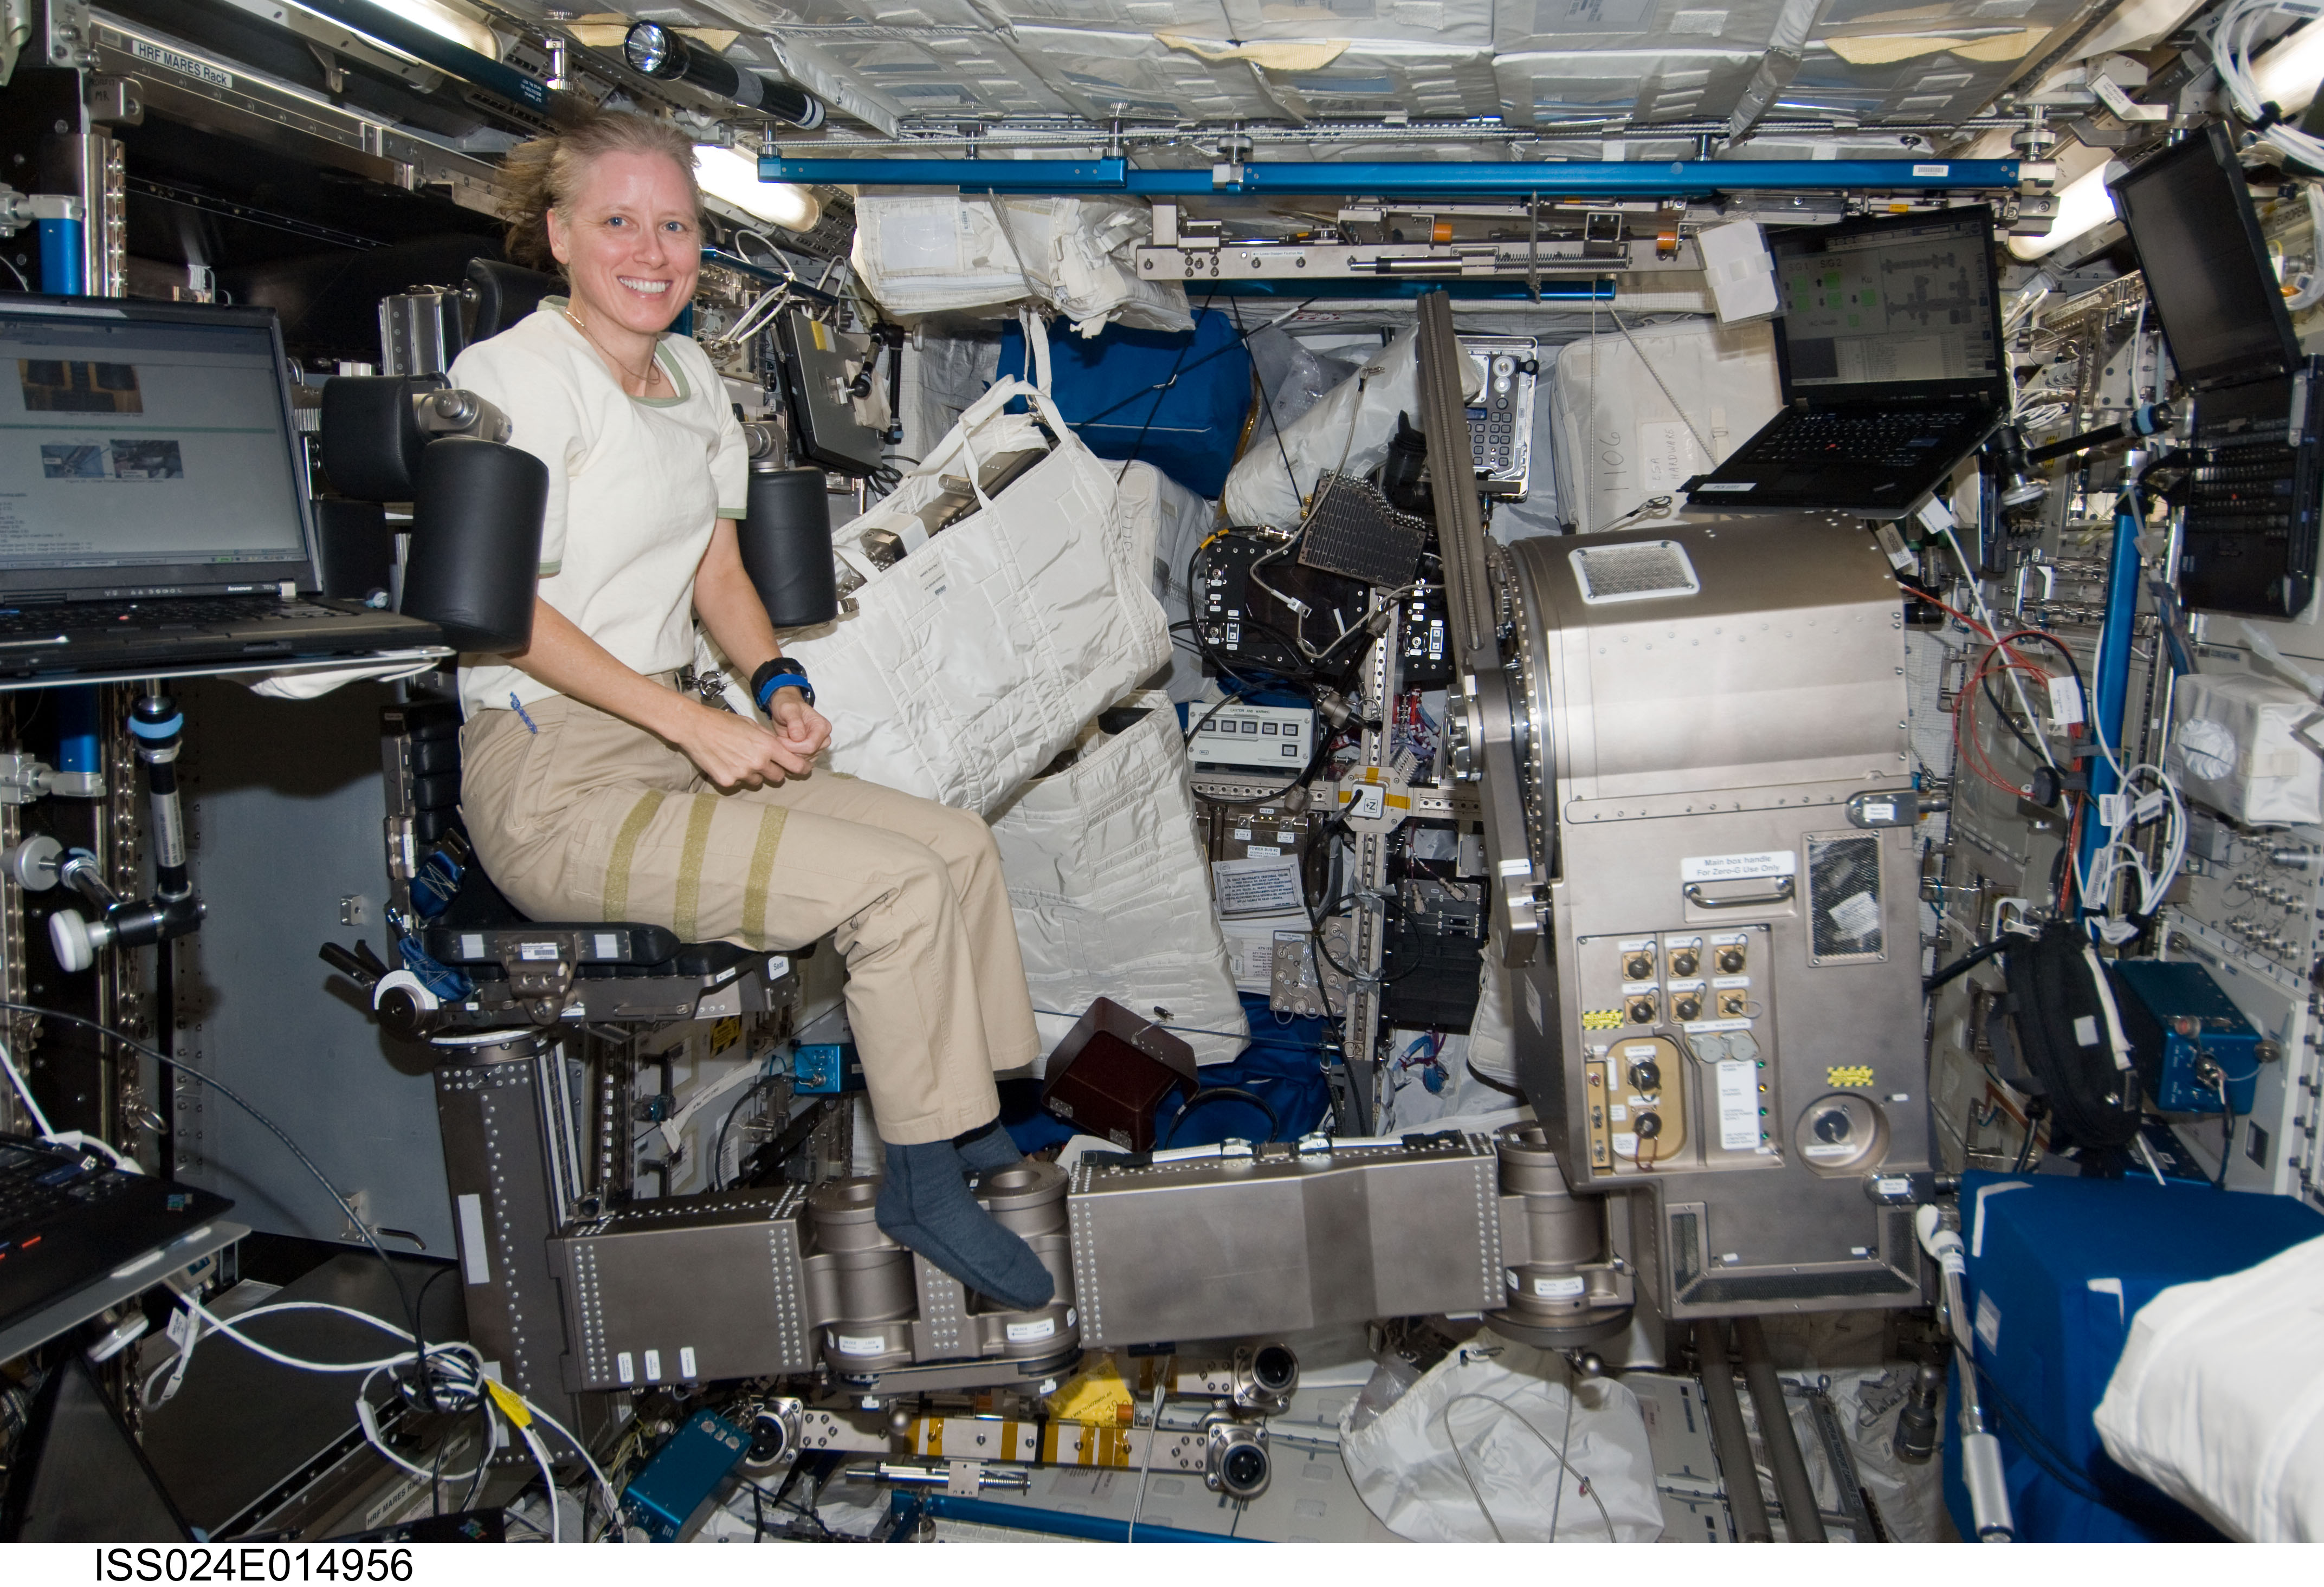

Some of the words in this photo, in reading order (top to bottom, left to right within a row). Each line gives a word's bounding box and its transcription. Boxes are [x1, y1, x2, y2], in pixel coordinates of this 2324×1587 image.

[139, 43, 161, 59] HRF
[164, 53, 201, 76] MARES
[204, 67, 227, 86] Rack
[1861, 275, 1873, 284] Ku
[1599, 432, 1629, 491] 1106
[1664, 429, 1680, 480] HARDWARE
[1650, 457, 1662, 481] ESA
[1365, 801, 1376, 810] +Z
[1713, 867, 1741, 875] Zero-G
[1761, 864, 1780, 872] Only
[1744, 856, 1772, 864] handle
[773, 961, 784, 970] Seat
[1083, 1395, 1106, 1412] HORIZONTAL
[367, 1509, 382, 1525] HRF
[383, 1490, 406, 1511] MARES
[450, 1435, 470, 1456] Drawer
[410, 1495, 430, 1516] CONTENTS
